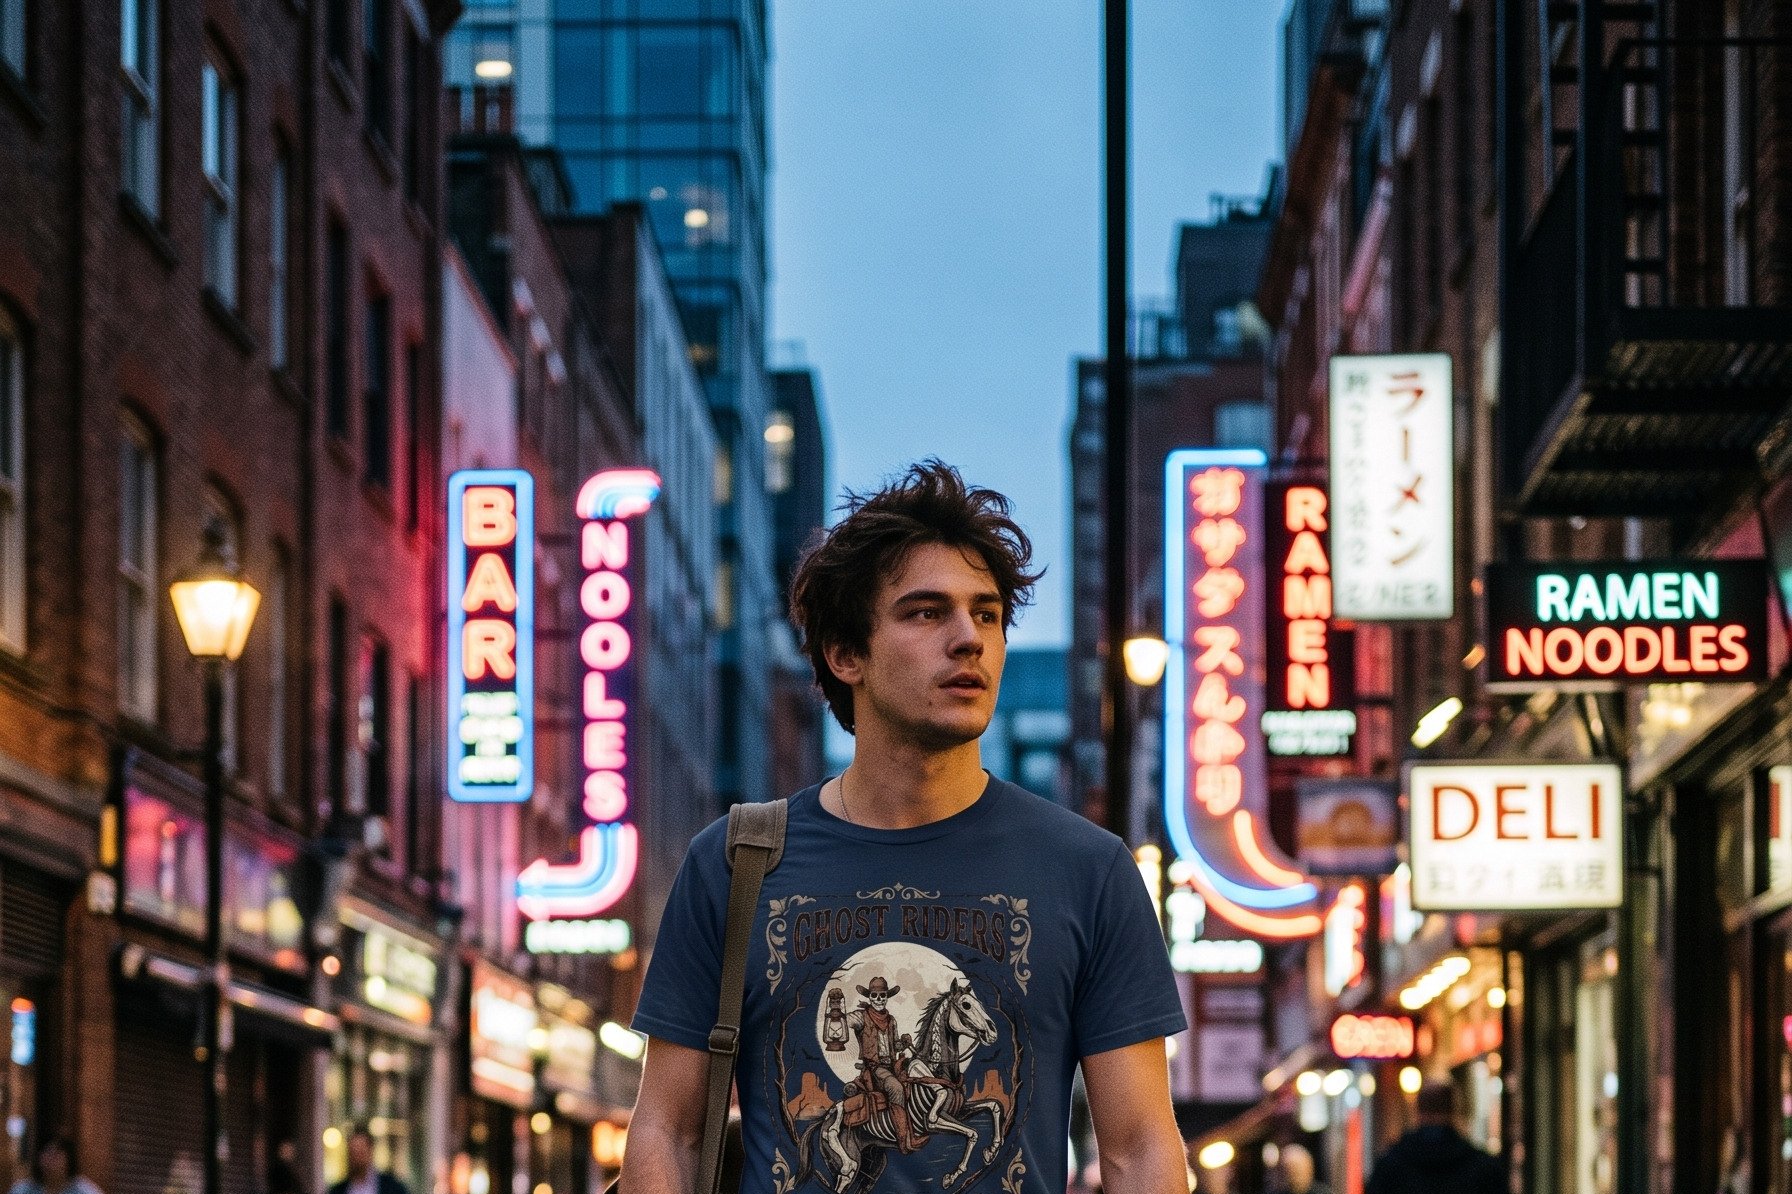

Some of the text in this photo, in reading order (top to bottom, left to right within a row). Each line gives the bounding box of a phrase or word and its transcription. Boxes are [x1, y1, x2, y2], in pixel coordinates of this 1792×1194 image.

[1386, 372, 1430, 567] ラーメン
[461, 486, 517, 680] BAR
[1283, 486, 1333, 709] RAMEN
[1536, 571, 1720, 622] RAMEN
[579, 521, 631, 822] NOOLES
[1505, 625, 1750, 676] NOODLES
[1431, 783, 1602, 841] DELI
[793, 905, 1007, 962] GHOST RIDERS
